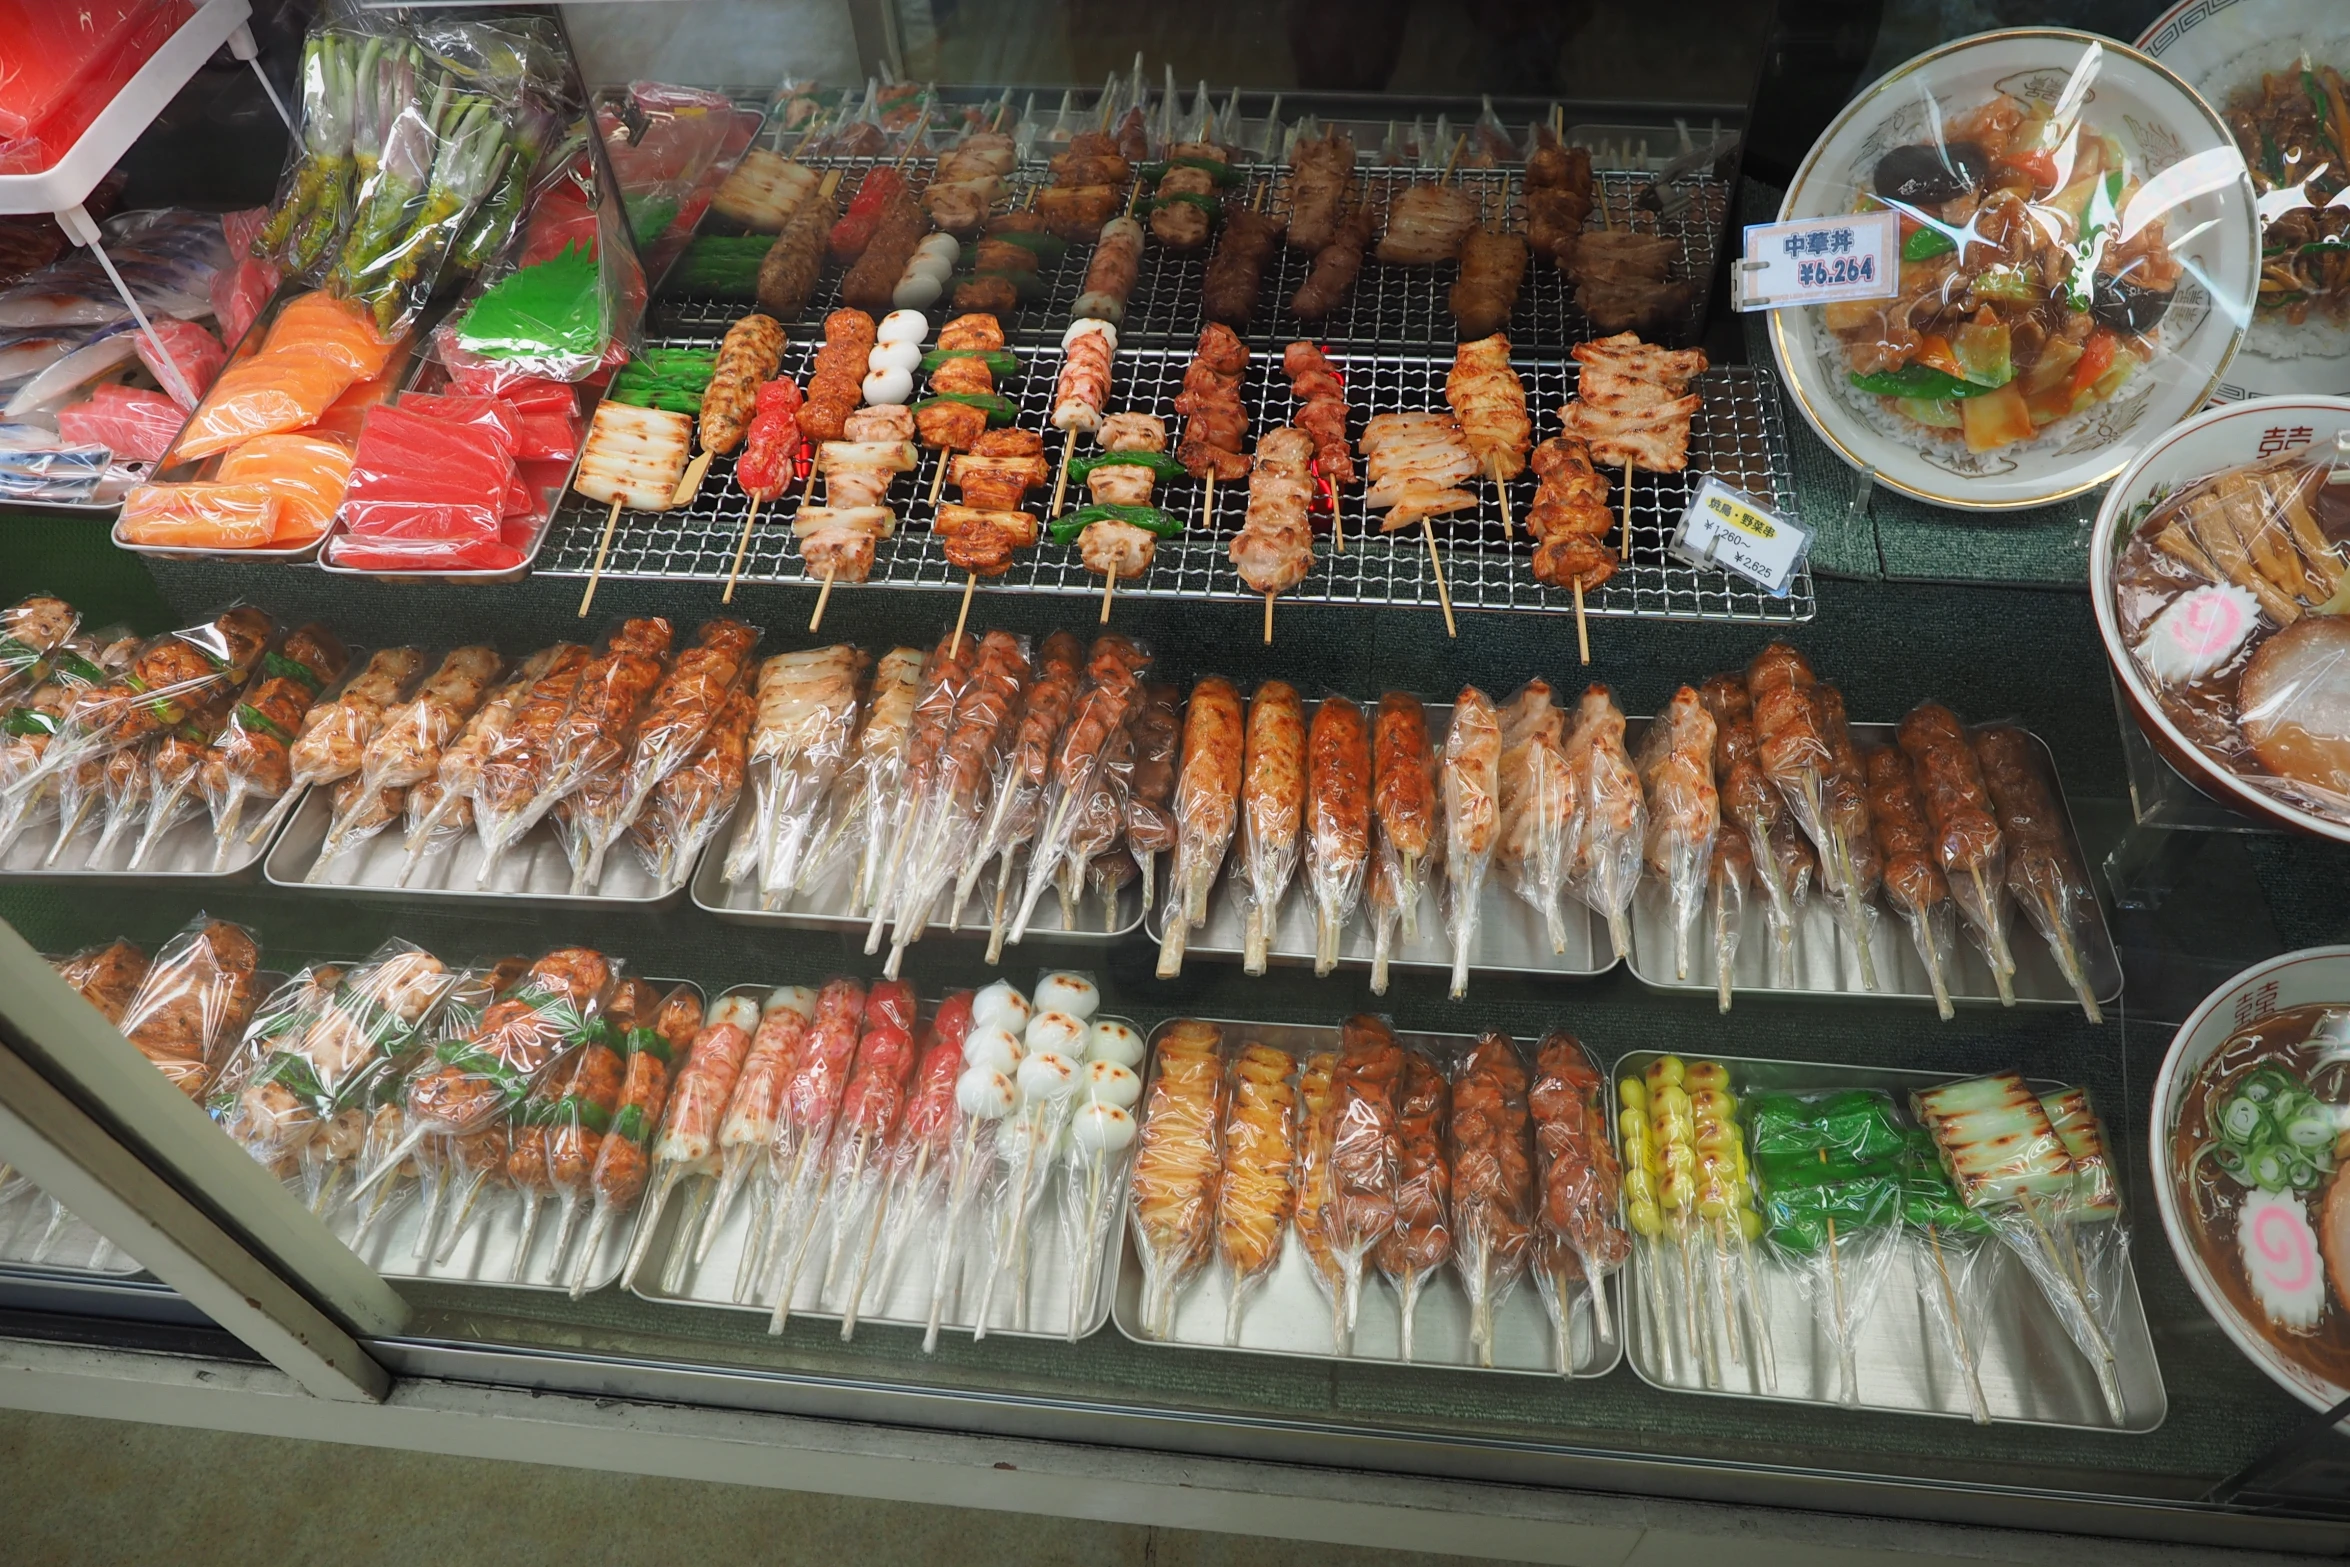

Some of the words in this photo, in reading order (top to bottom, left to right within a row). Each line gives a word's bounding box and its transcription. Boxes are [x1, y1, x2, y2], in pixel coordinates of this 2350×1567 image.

[1784, 228, 1854, 258] 中華丼
[1708, 497, 1776, 538] 焼鳥・野菜串
